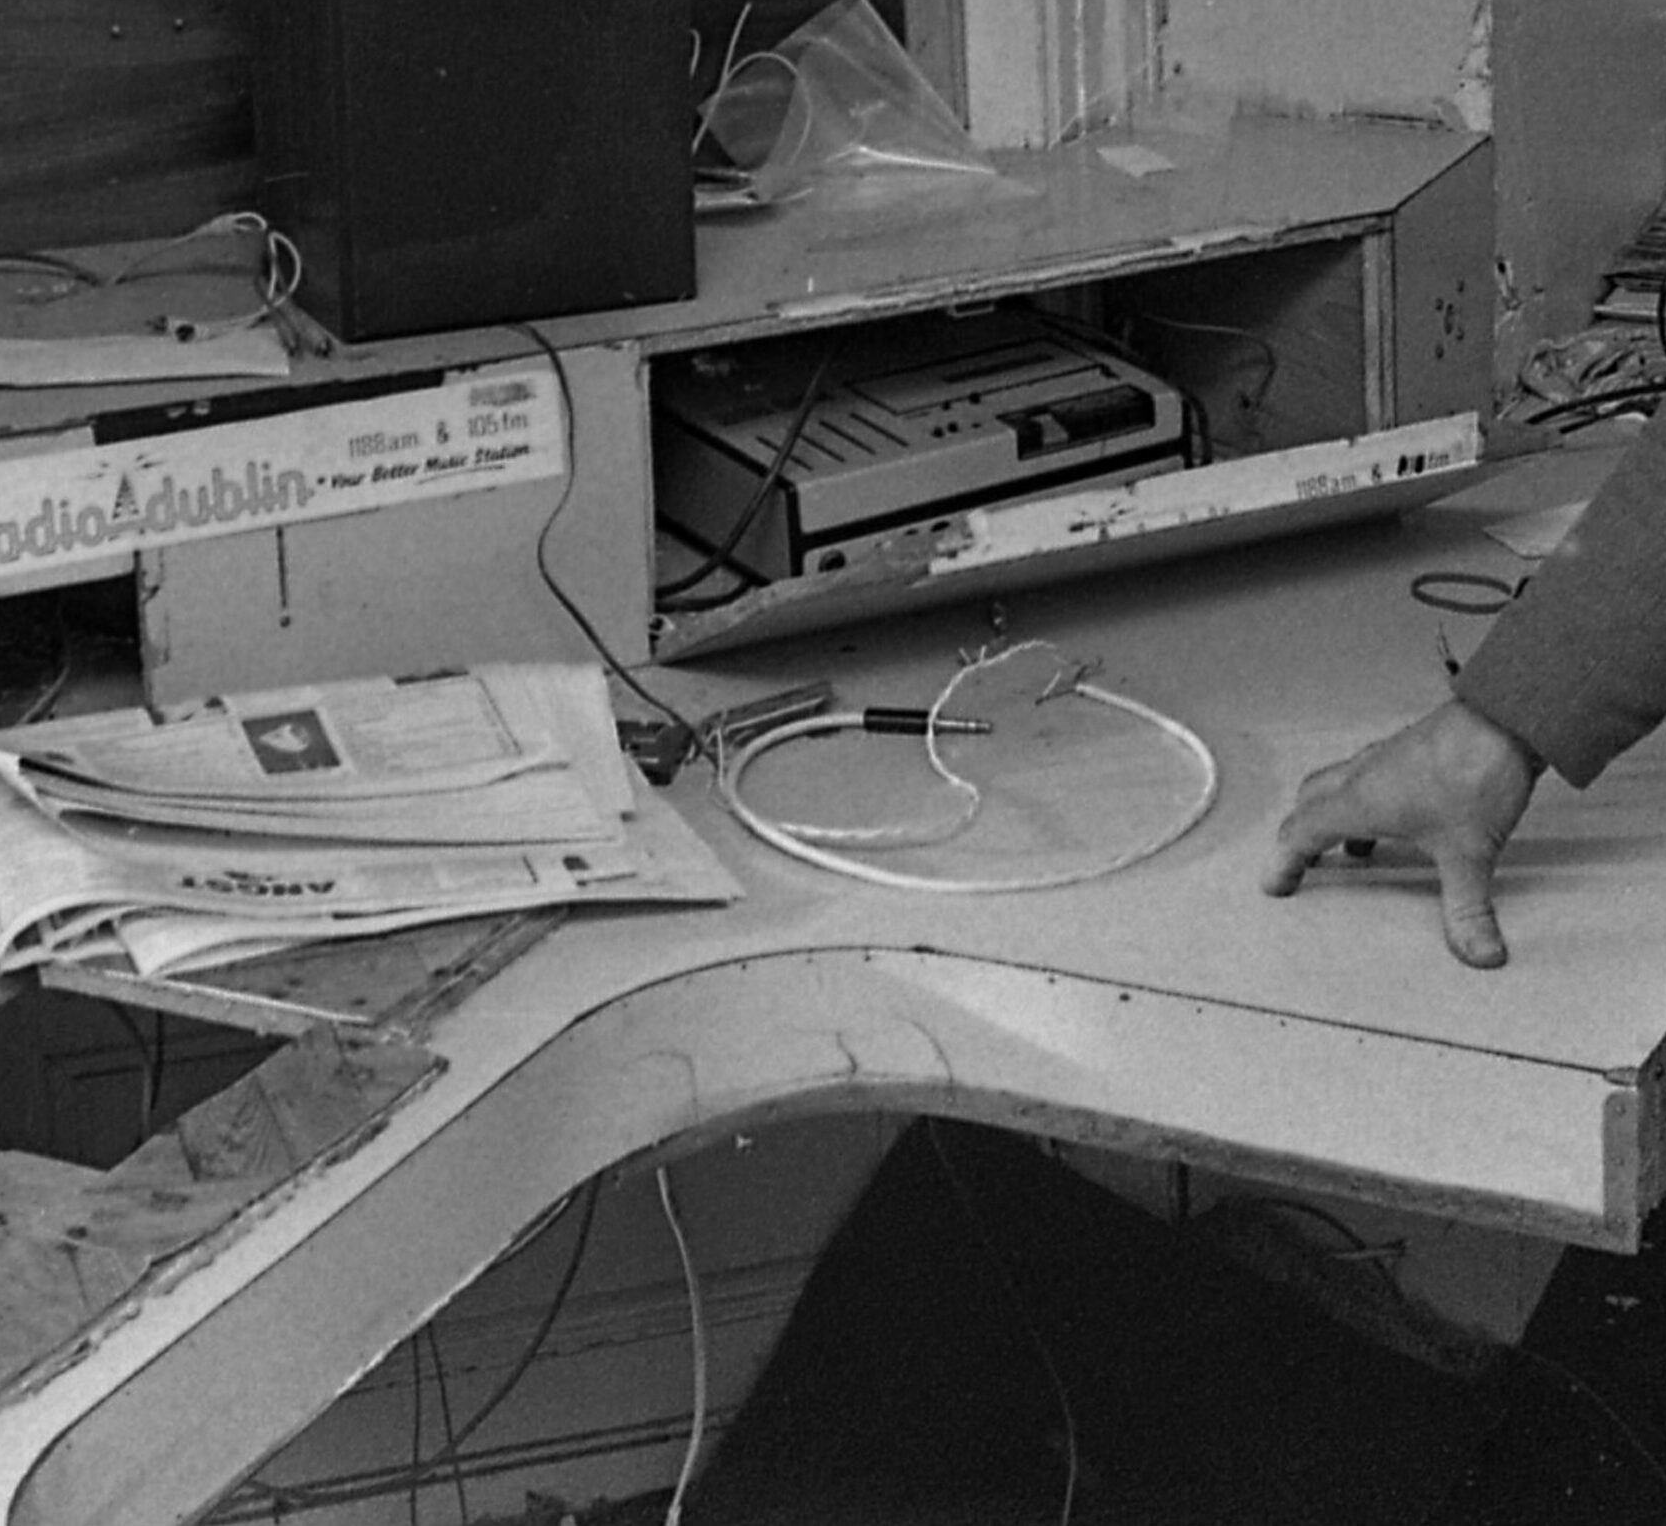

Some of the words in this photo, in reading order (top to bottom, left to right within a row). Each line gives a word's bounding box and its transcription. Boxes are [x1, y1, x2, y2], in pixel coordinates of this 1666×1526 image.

[436, 420, 450, 445] &
[331, 473, 366, 489] Your
[372, 463, 420, 483] Better
[425, 455, 469, 472] Music
[145, 460, 314, 533] dublin
